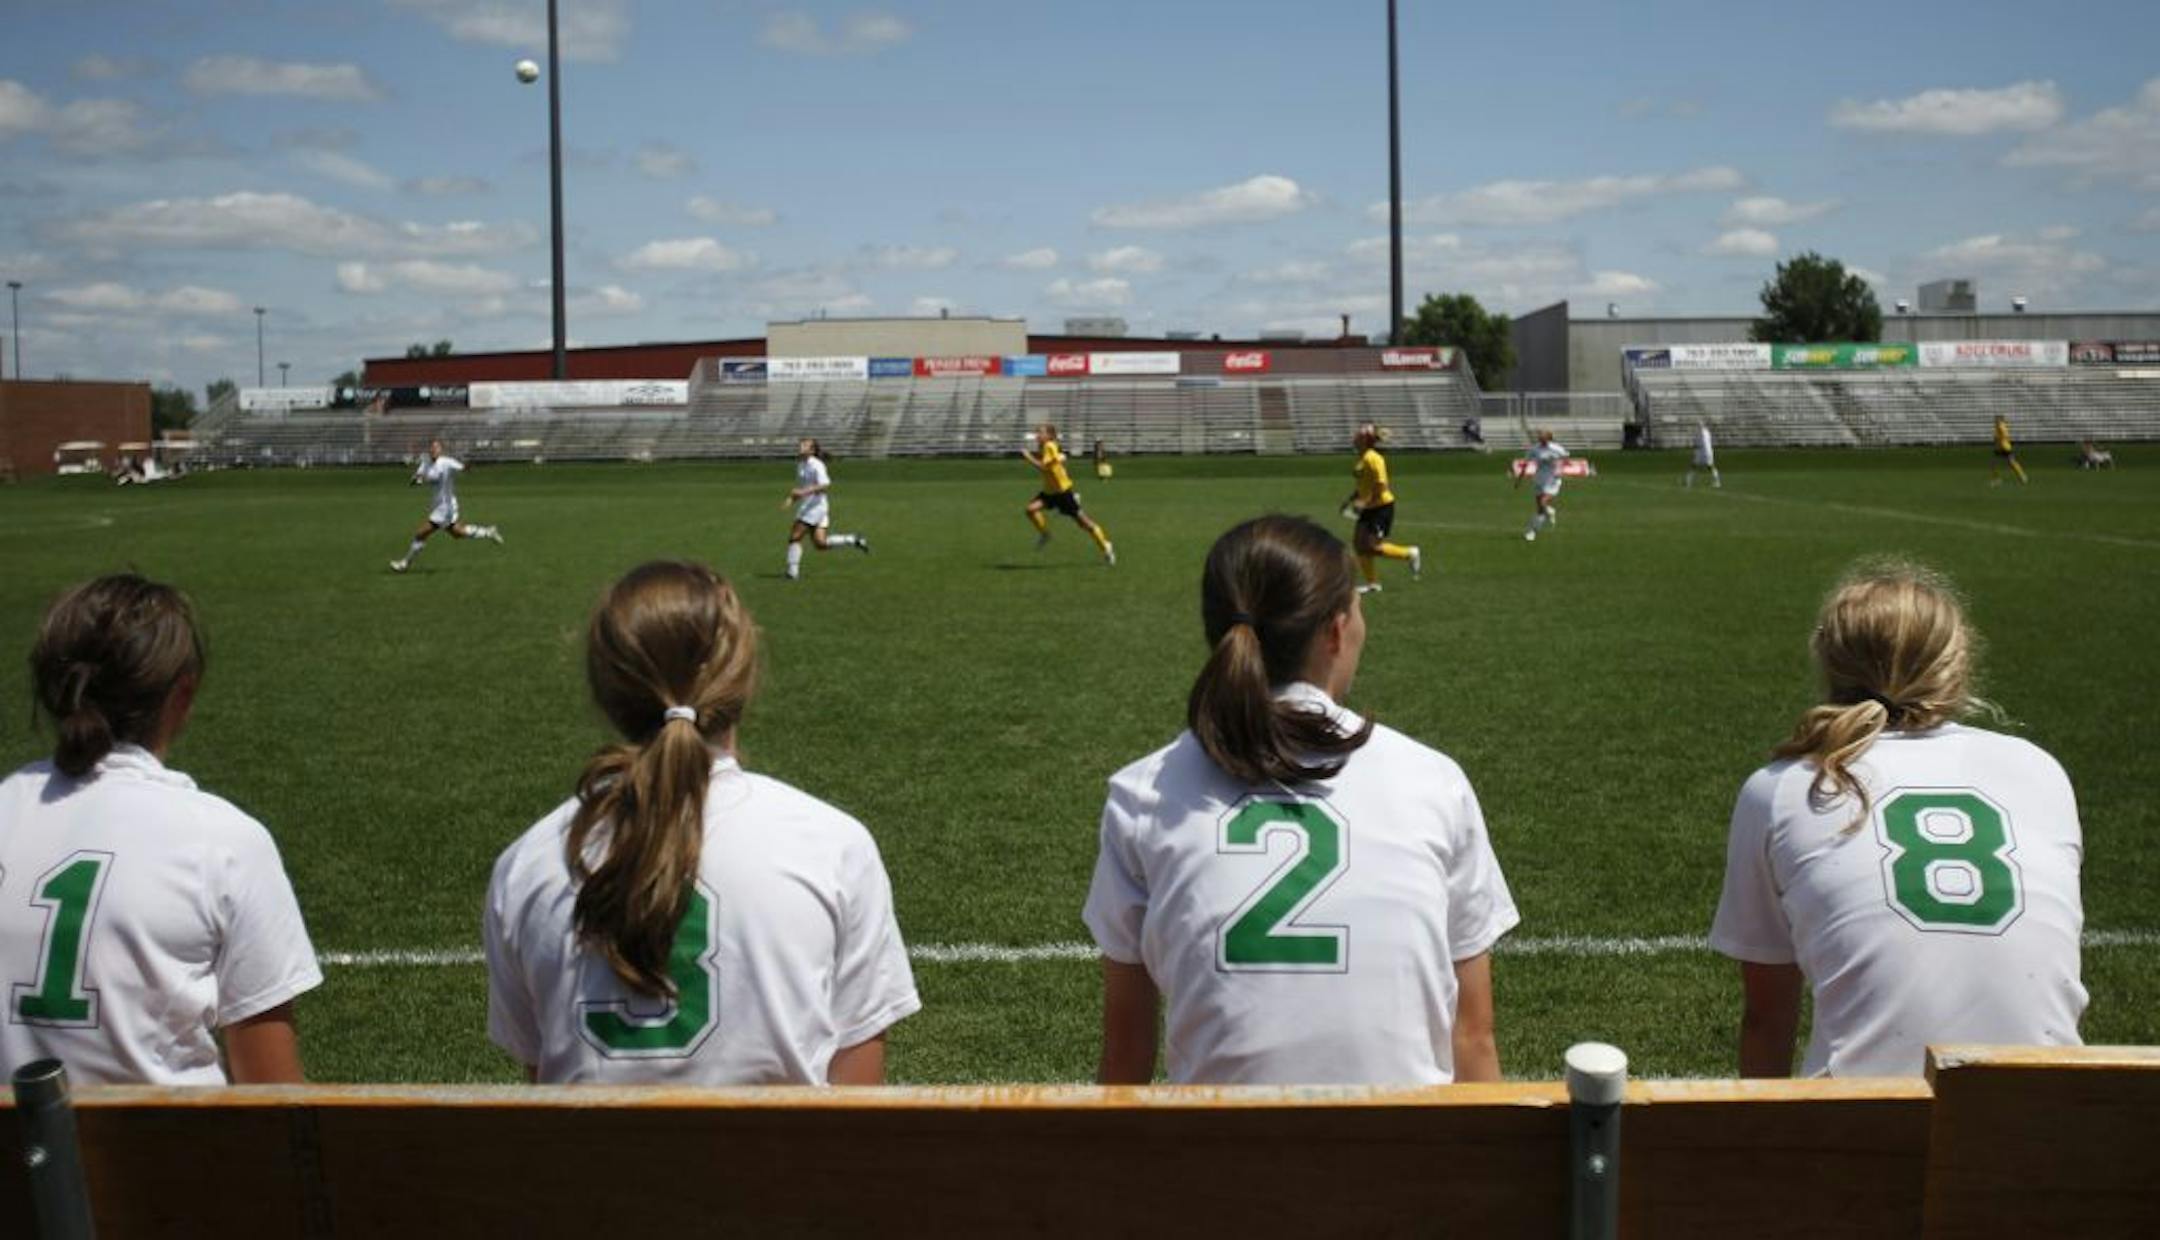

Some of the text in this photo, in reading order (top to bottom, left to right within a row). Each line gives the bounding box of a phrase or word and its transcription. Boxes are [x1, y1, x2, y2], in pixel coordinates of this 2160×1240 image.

[1216, 793, 1350, 973] 2
[1873, 786, 2025, 936] 8
[576, 878, 719, 1059] 3
